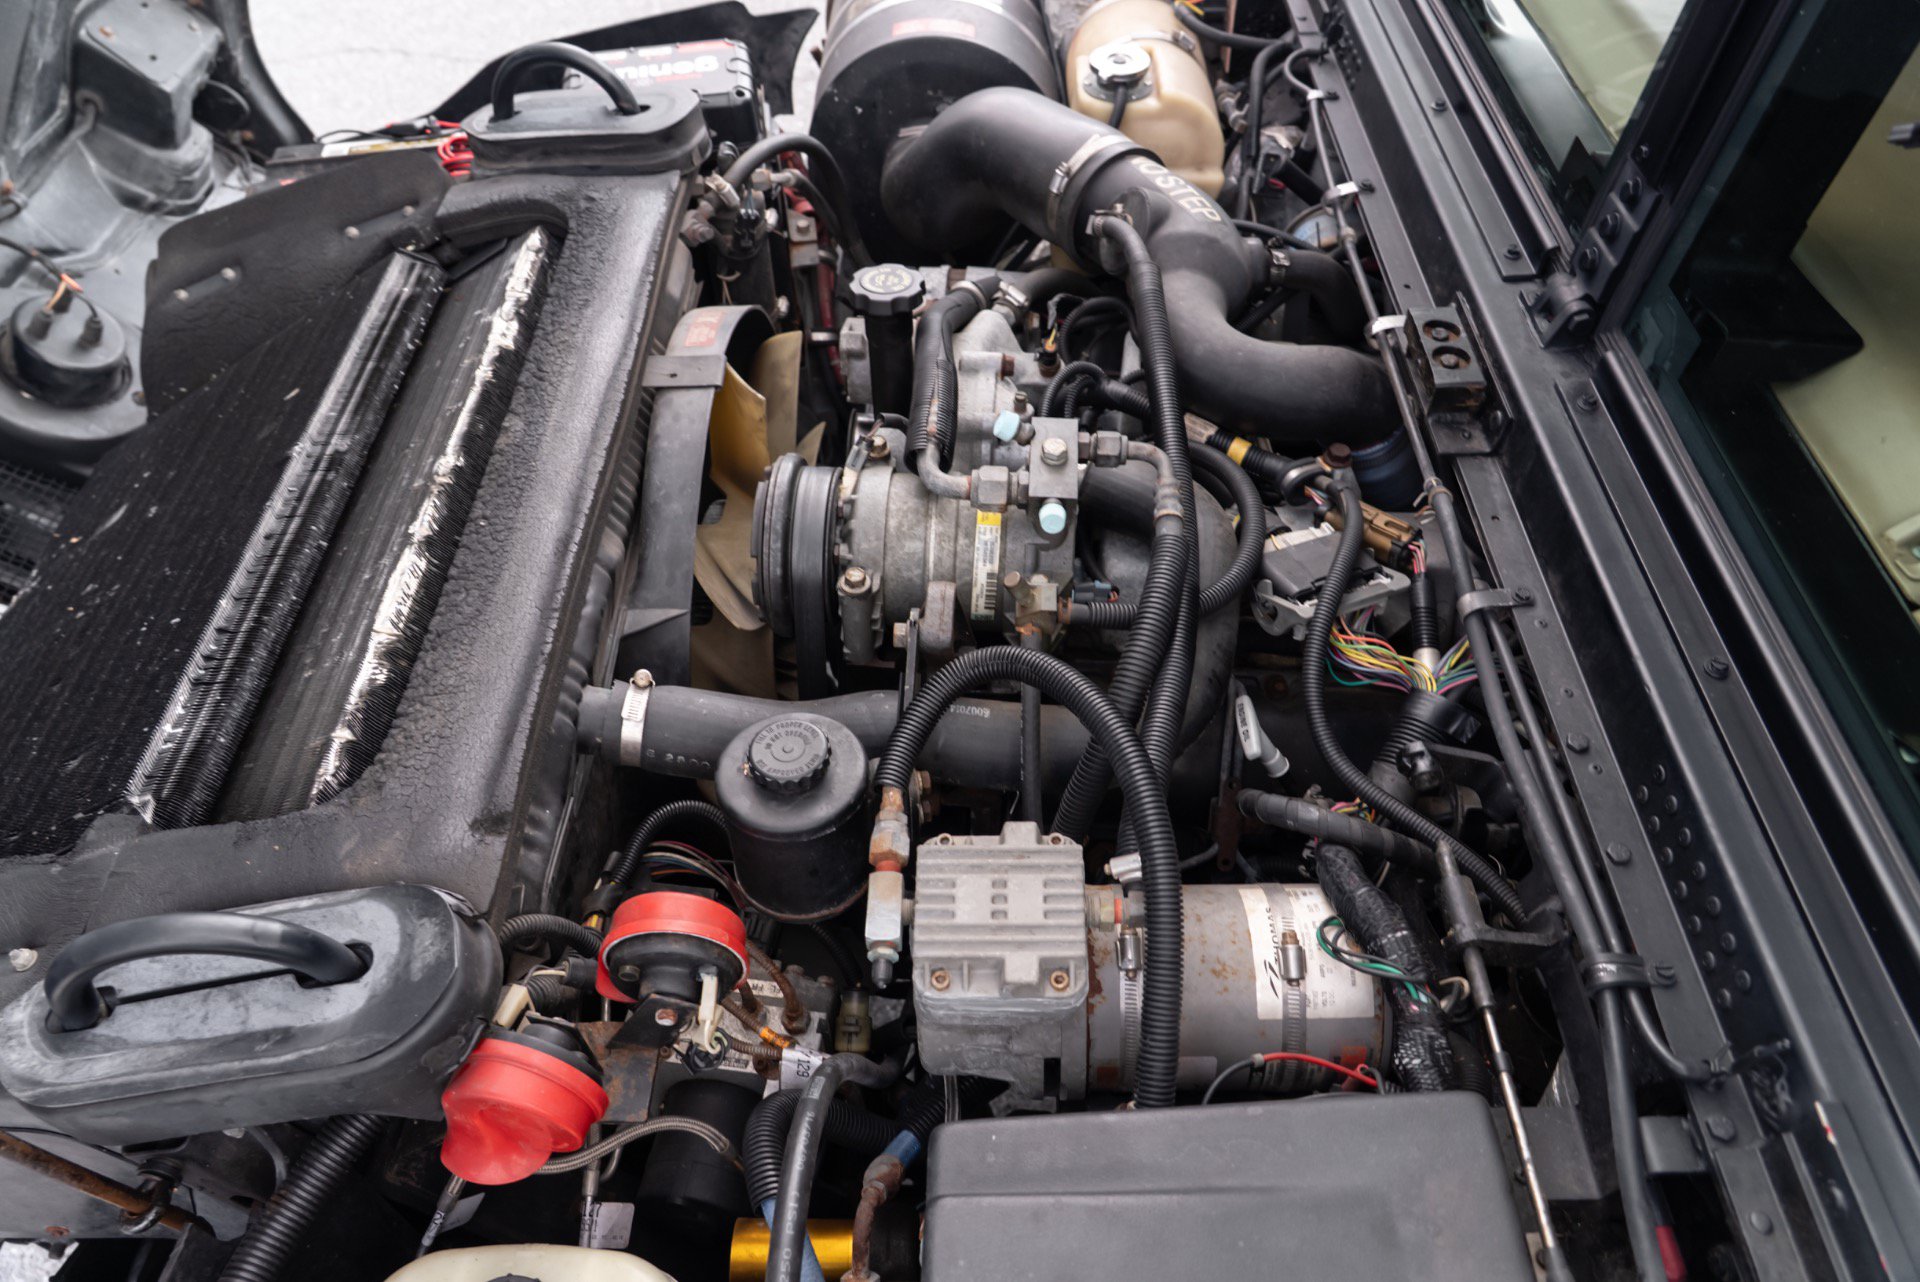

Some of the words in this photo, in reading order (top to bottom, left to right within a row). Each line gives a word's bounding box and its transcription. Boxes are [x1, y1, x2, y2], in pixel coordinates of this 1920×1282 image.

[615, 55, 719, 79] geniu
[1155, 175, 1221, 222] STEP
[1237, 702, 1248, 729] ENGINE
[779, 1247, 793, 1282] 250
